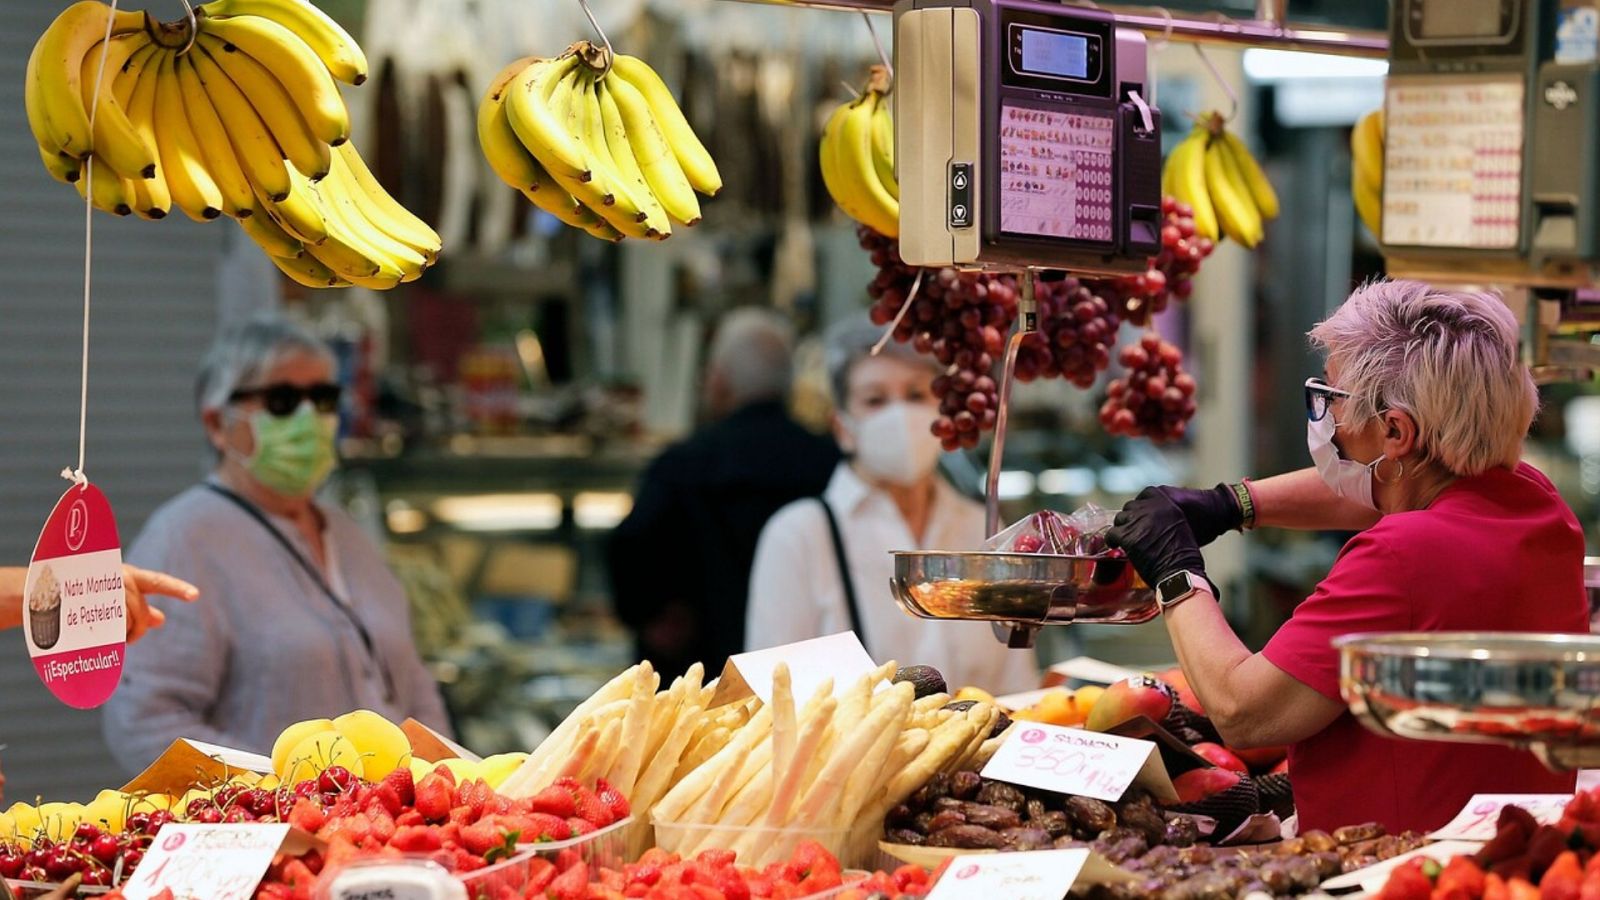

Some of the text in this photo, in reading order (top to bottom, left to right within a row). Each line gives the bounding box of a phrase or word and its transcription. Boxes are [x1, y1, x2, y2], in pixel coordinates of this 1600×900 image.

[64, 572, 122, 597] Nata Montada
[67, 600, 123, 626] de Pastelería
[43, 650, 121, 682] ¡¡Espectacular!!
